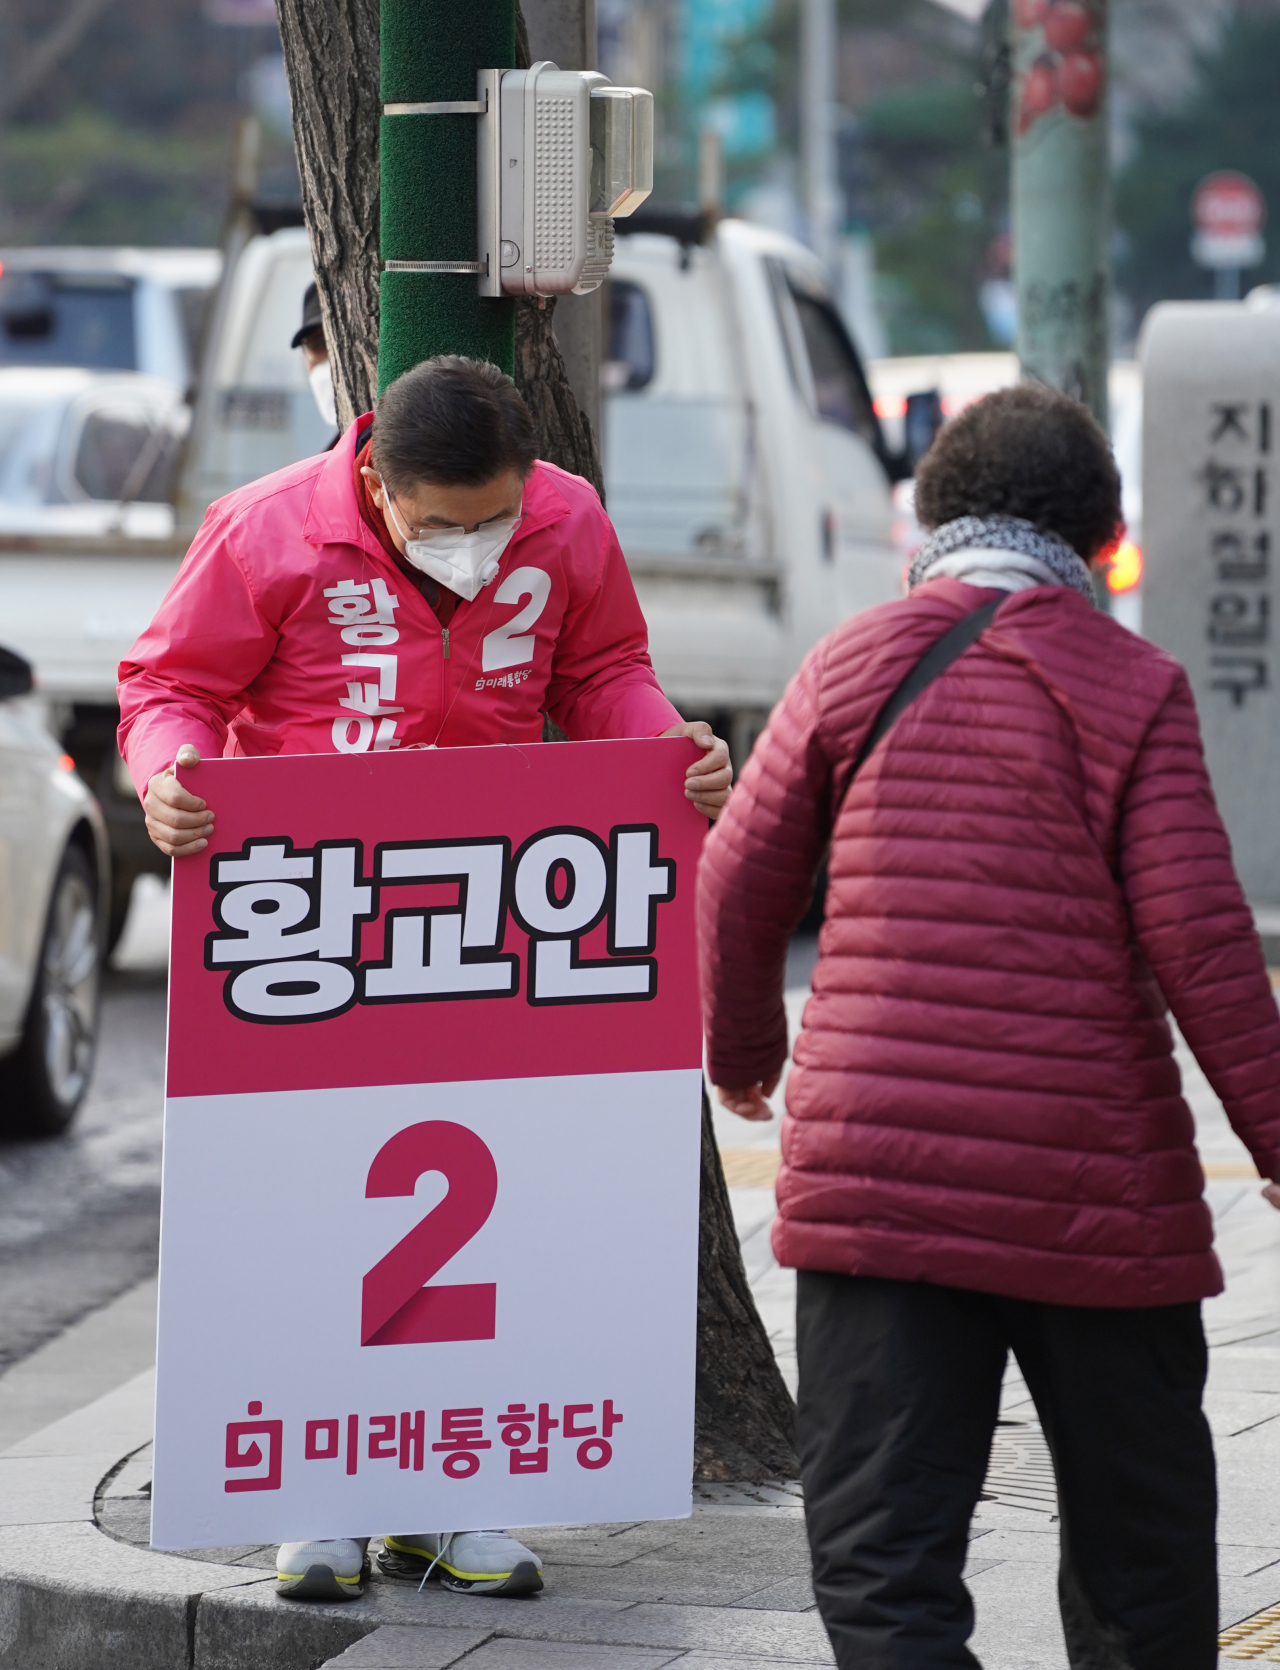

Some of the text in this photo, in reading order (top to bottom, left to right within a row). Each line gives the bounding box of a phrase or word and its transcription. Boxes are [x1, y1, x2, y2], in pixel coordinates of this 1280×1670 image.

[482, 566, 551, 672] 2
[486, 669, 532, 688] 미래통합당
[206, 825, 674, 1021] 황교안
[361, 1120, 498, 1347] 2
[305, 1399, 623, 1479] 미래통합당
